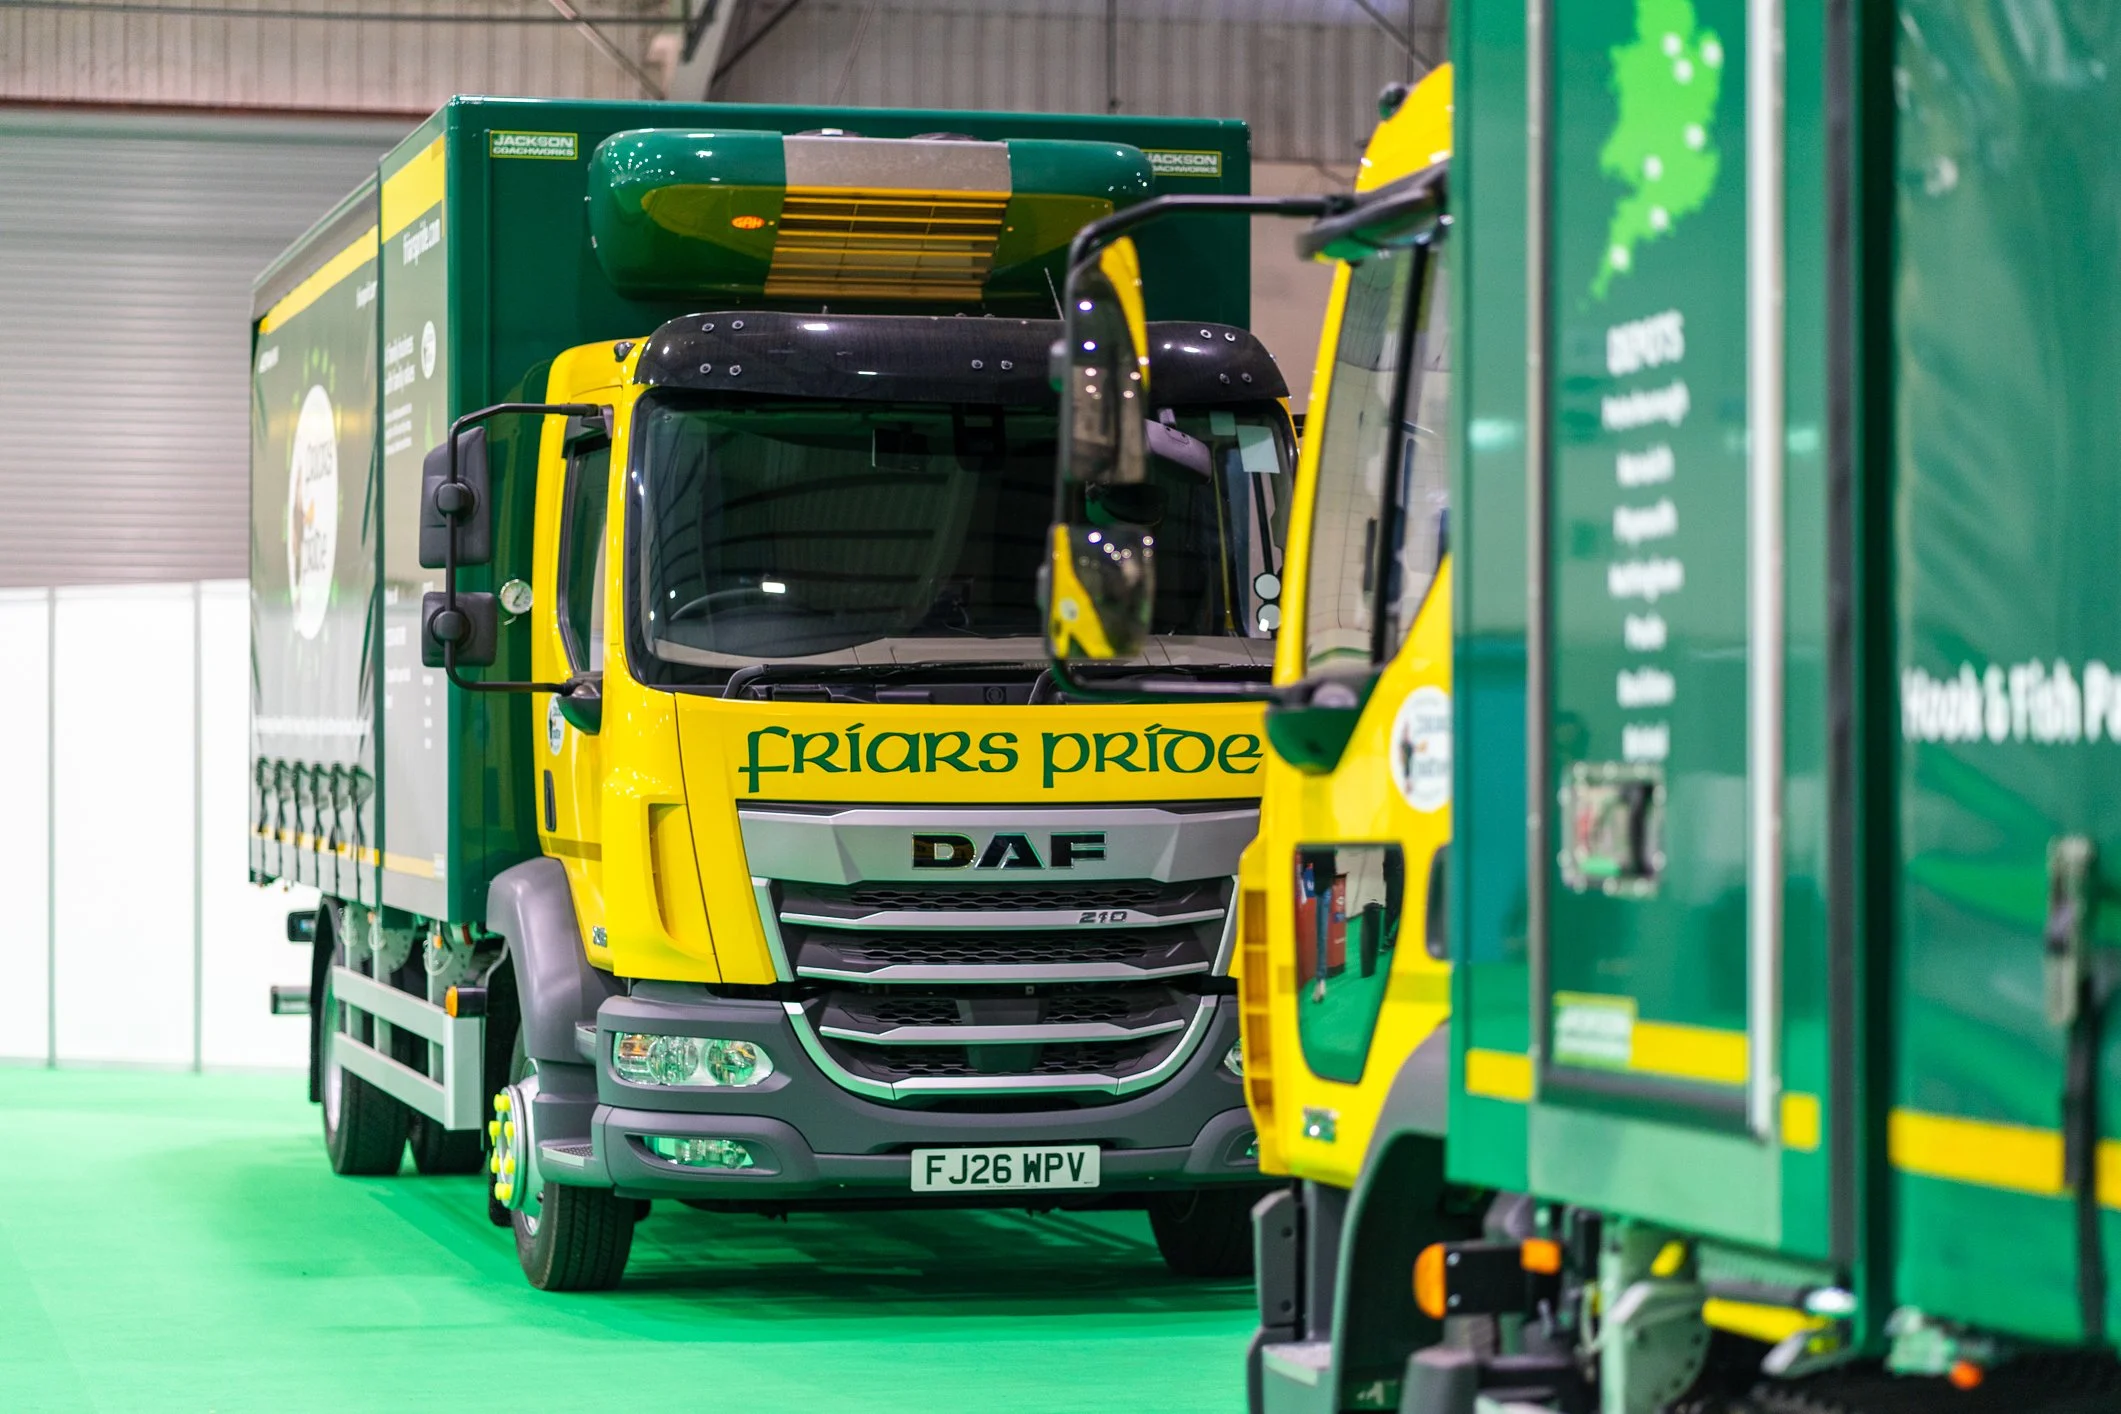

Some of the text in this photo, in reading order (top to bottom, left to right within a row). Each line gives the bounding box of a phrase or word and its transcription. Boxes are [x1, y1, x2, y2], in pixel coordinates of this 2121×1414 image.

[493, 134, 574, 148] JACKSON
[492, 146, 575, 157] COACHWORKS
[911, 831, 1108, 870] DAF
[1079, 911, 1128, 924] 210
[926, 1152, 1086, 1185] FJ26 WPV
